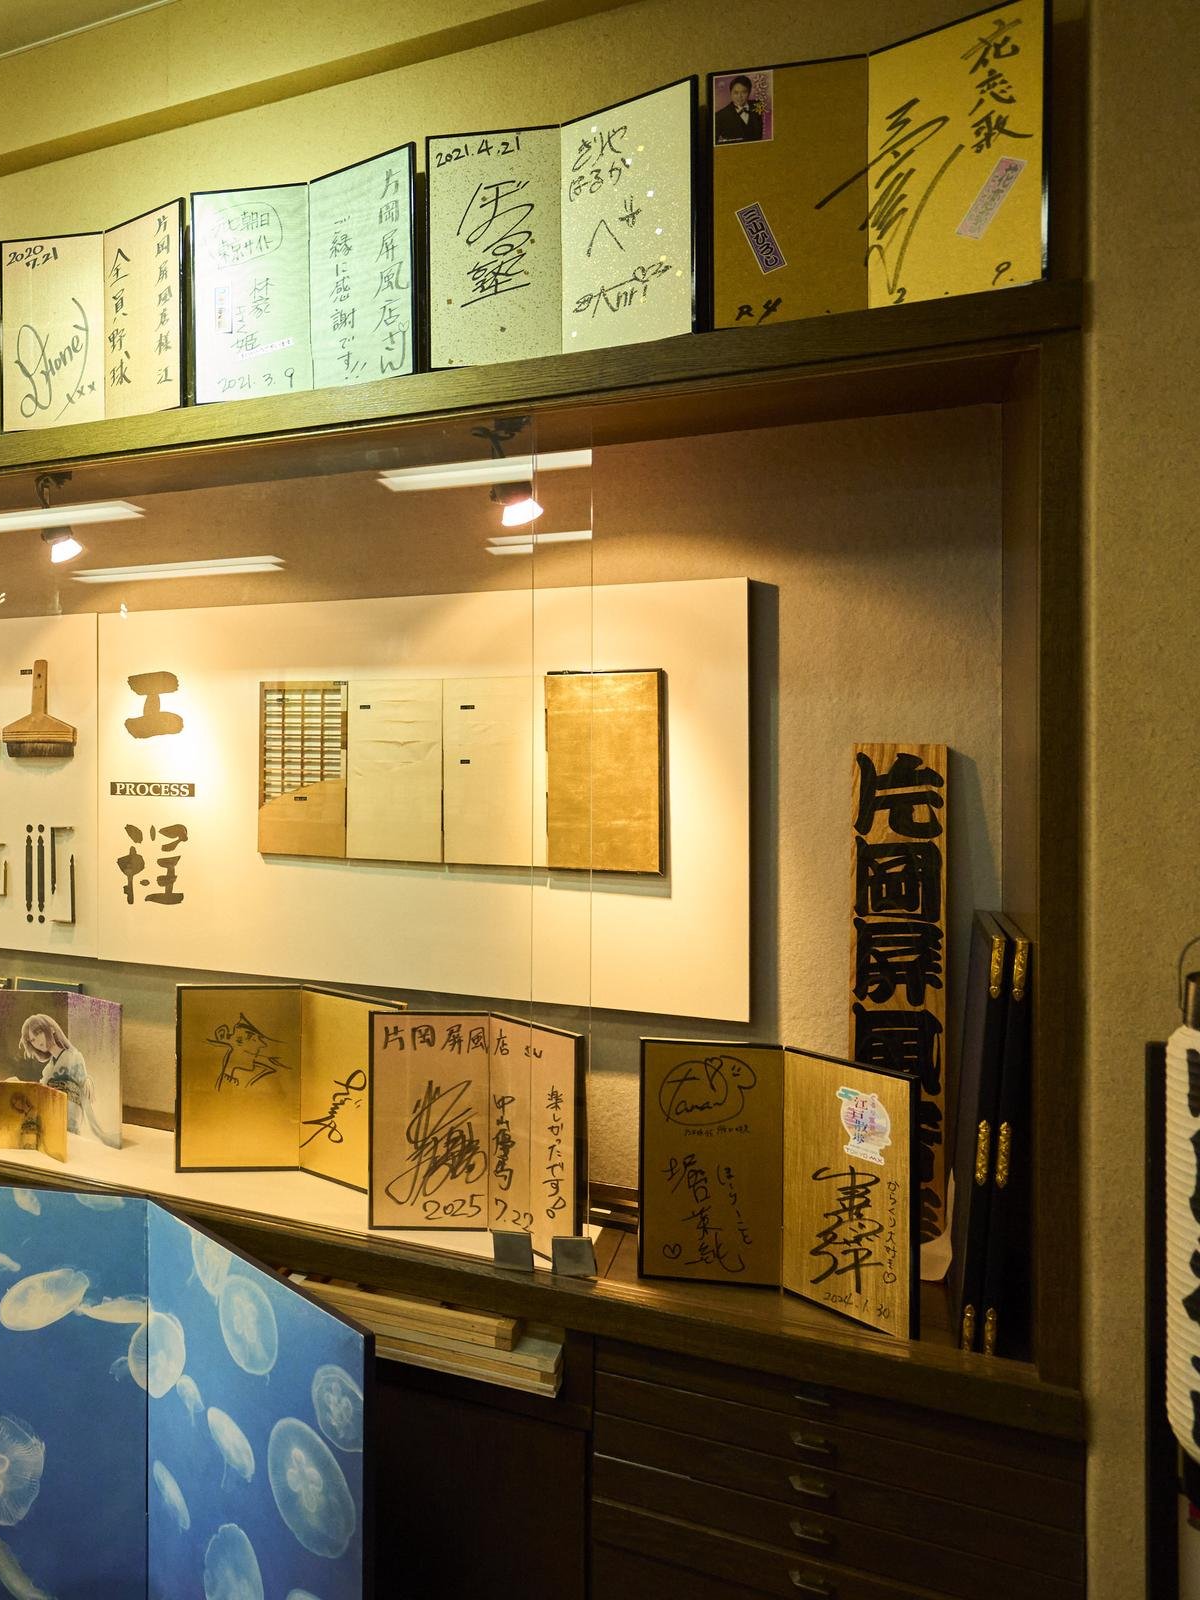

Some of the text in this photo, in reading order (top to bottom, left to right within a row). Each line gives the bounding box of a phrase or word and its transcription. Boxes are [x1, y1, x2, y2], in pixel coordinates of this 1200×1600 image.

[6, 244, 44, 267] 2020
[108, 248, 132, 388] 全員野球
[116, 782, 190, 797] PROCESS
[423, 1193, 481, 1220] 2025
